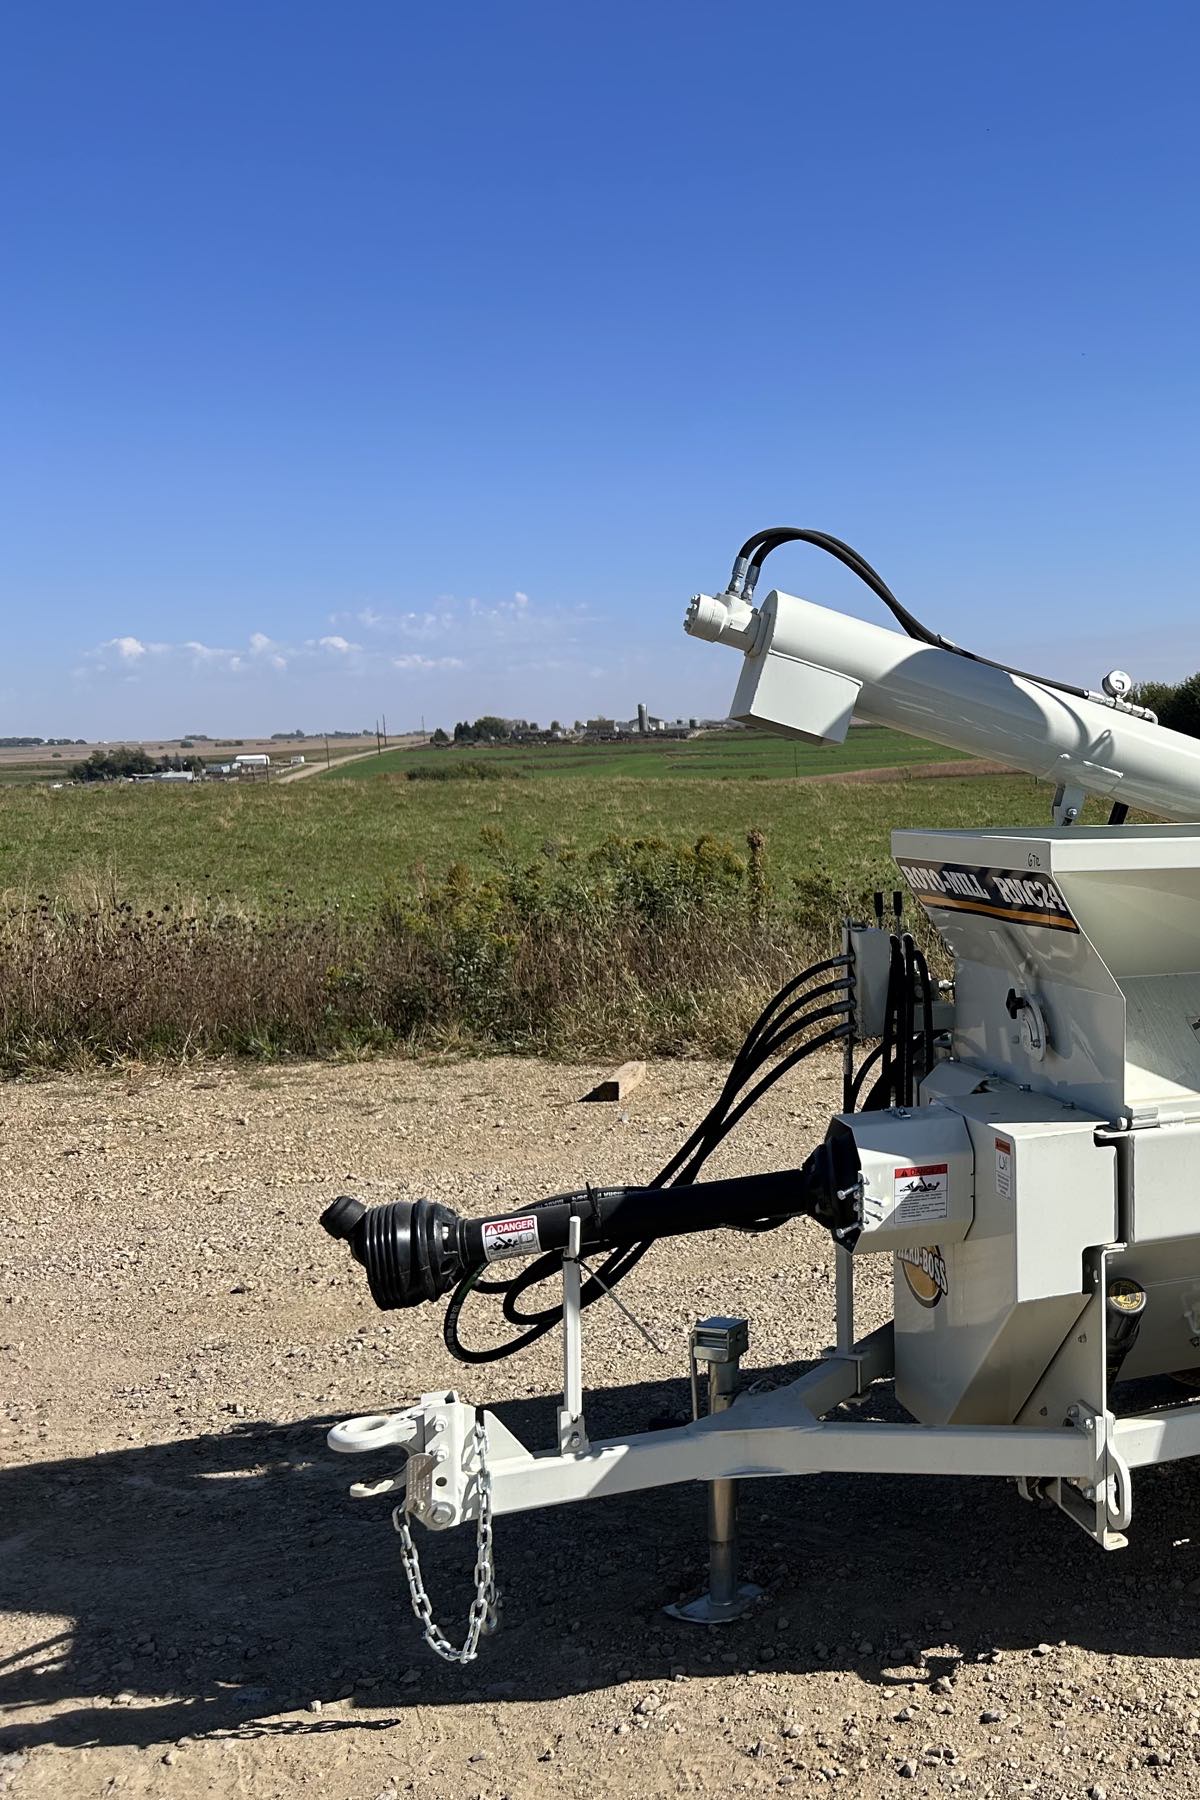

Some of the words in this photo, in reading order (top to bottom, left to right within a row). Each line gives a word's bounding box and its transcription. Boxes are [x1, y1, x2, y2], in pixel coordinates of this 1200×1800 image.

[901, 865, 992, 900] ROTO-MILL
[992, 876, 1068, 912] RMC24
[497, 1219, 534, 1233] DANGER
